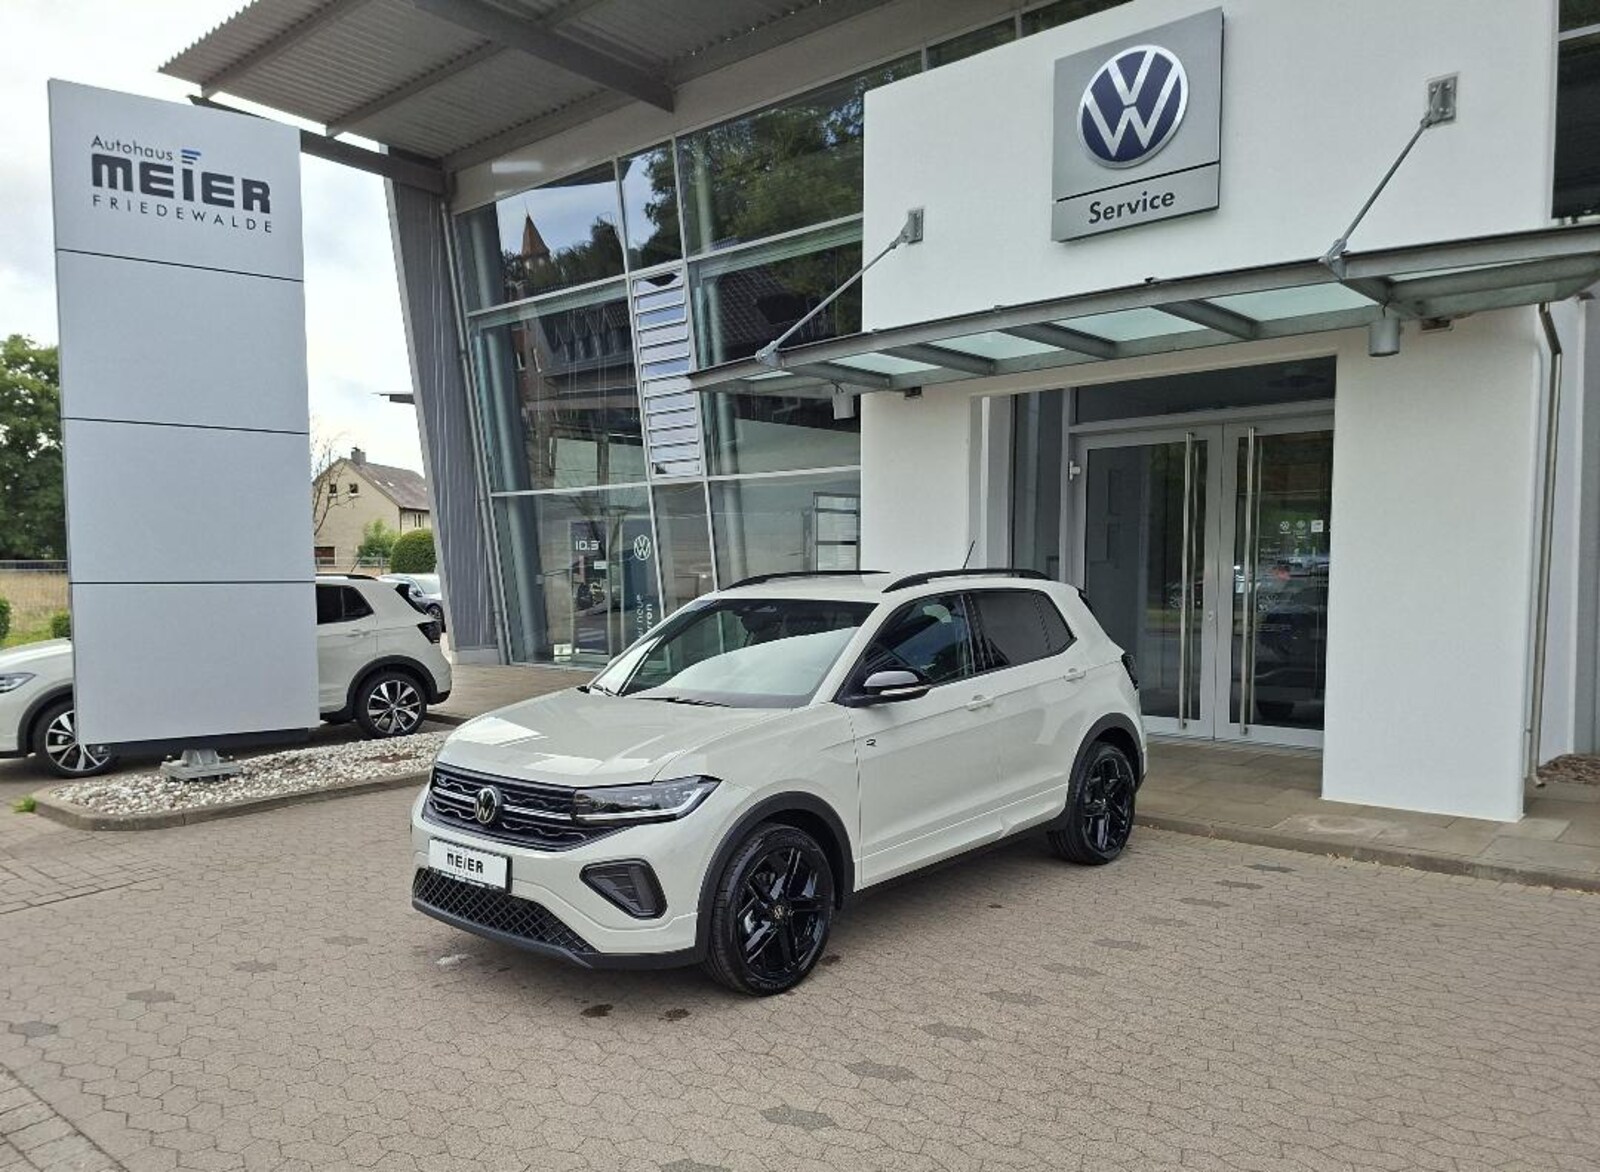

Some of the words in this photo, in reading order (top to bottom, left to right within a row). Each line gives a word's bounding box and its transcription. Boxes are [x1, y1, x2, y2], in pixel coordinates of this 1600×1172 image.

[91, 135, 173, 161] Autohaus
[91, 149, 271, 214] MEIER
[92, 194, 272, 234] FRIEDEWALDE
[1088, 190, 1175, 224] Service
